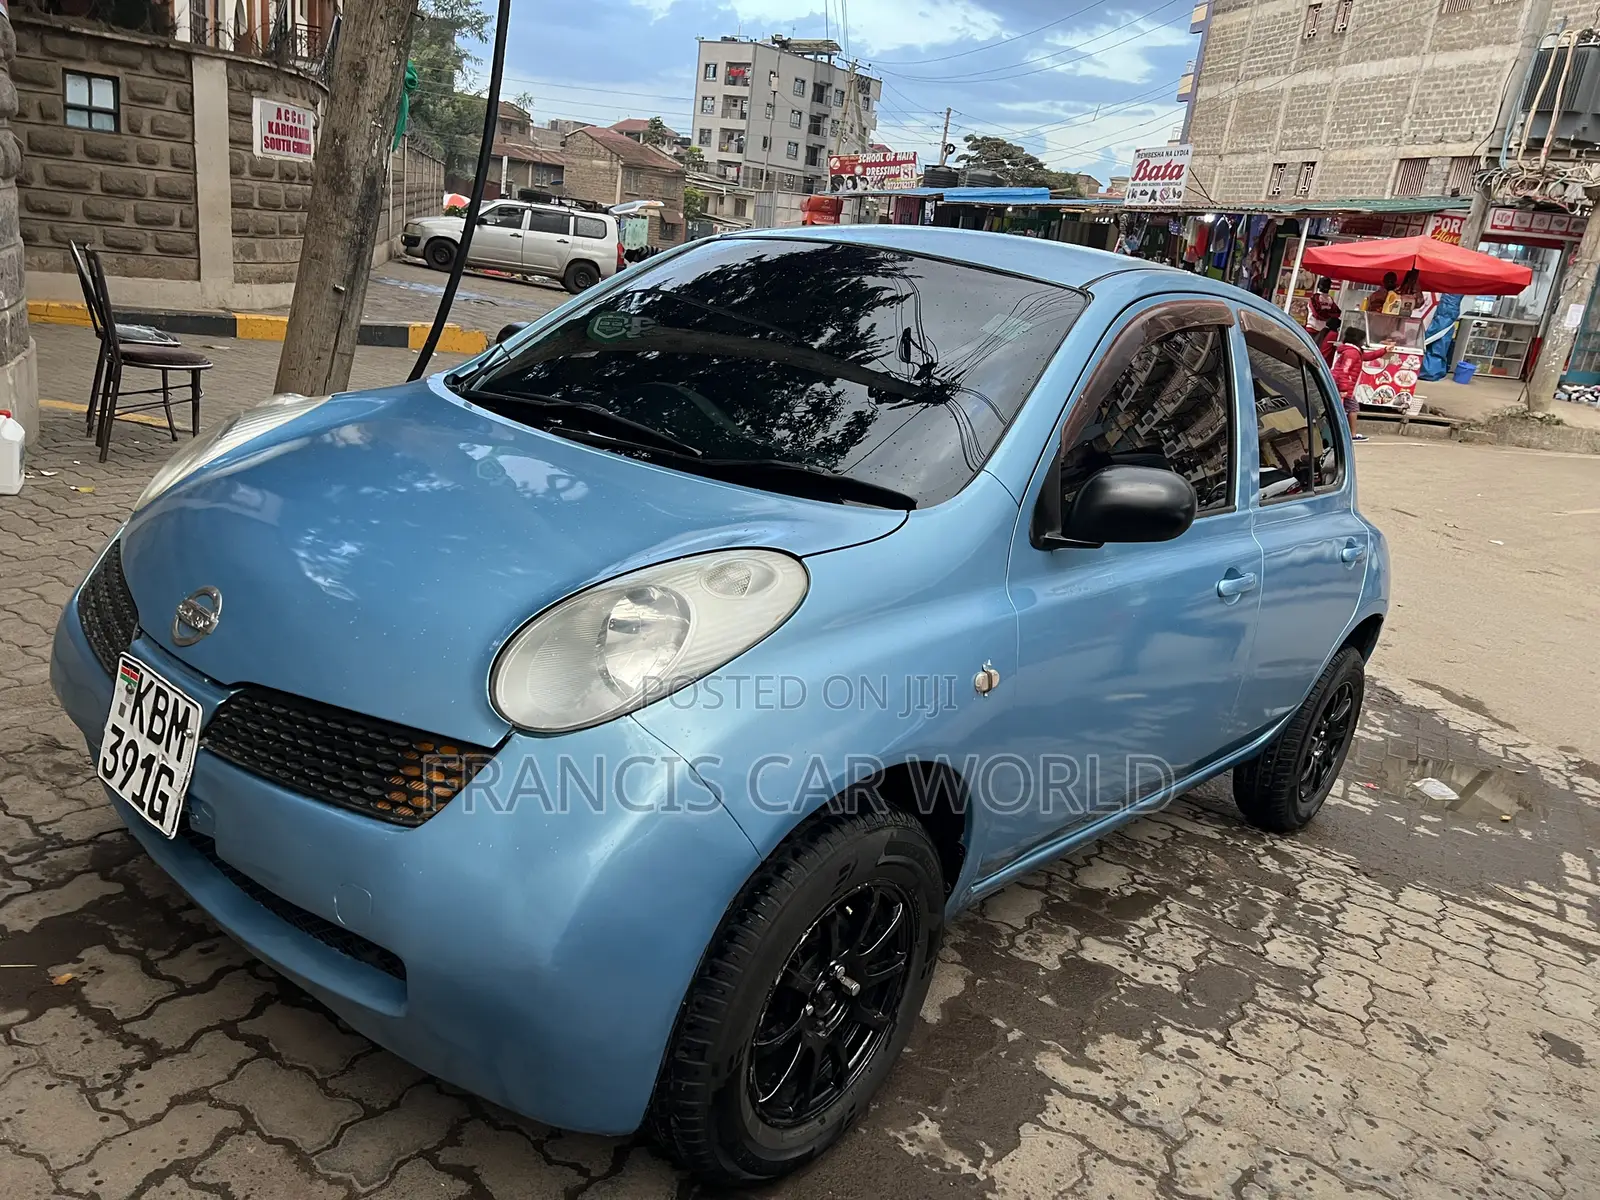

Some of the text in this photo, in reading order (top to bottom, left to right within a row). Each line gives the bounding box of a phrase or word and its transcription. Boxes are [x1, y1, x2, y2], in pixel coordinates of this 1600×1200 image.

[264, 136, 291, 152] SOUTH
[858, 153, 884, 163] SCHOOL
[886, 152, 896, 161] OF
[896, 151, 914, 161] HAIR
[866, 166, 900, 176] DRESSING
[1131, 158, 1185, 182] Bata
[1432, 216, 1465, 234] POR
[1431, 228, 1460, 245] Have
[129, 672, 191, 763] KBM
[102, 723, 176, 827] 391G
